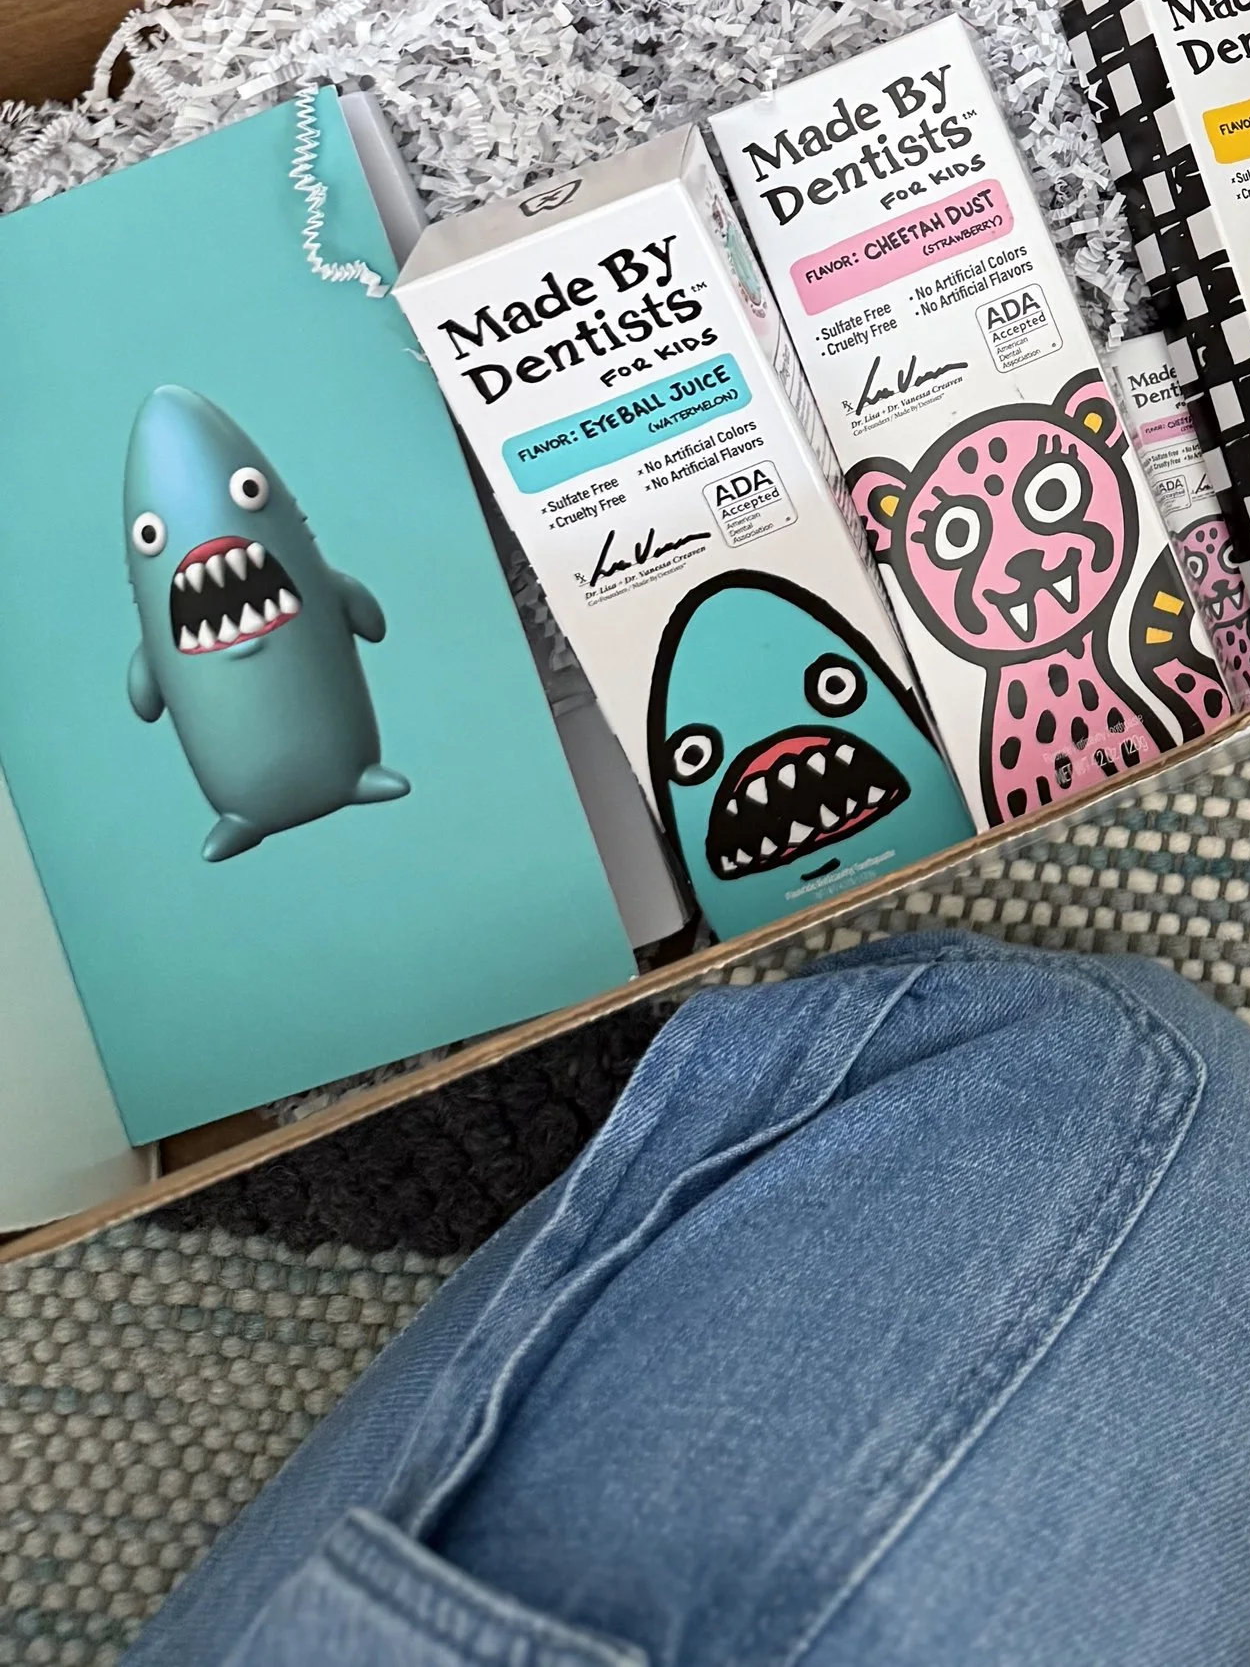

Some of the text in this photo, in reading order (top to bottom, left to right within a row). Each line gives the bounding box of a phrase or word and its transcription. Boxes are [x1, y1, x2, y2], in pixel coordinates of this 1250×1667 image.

[741, 63, 951, 182] Made By
[879, 153, 985, 210] FOR KIDS
[805, 188, 994, 283] FLAVOR: CHEETAH DUST
[922, 214, 1003, 256] (STRAWBERRY)
[914, 245, 1027, 300] No Artificial Colors
[919, 260, 1033, 316] No Artificial Flavors
[436, 234, 676, 360] Made By
[987, 291, 1041, 331] ADA
[820, 303, 891, 340] Sulfate Free
[826, 318, 897, 355] Cruelty Free
[992, 310, 1046, 343] Accepted
[599, 327, 718, 387] FOR KIDS
[517, 364, 731, 462] FLAVOR: EYEBALL JUICE
[647, 388, 738, 433] (WATERMELON)
[643, 421, 757, 473] No Artificial Colors
[650, 436, 764, 489] No Artificial Flavors
[546, 478, 619, 512] Sulfate Free
[554, 493, 626, 528] Cruelty Free
[715, 468, 774, 507] ADA
[717, 486, 780, 519] Accepted
